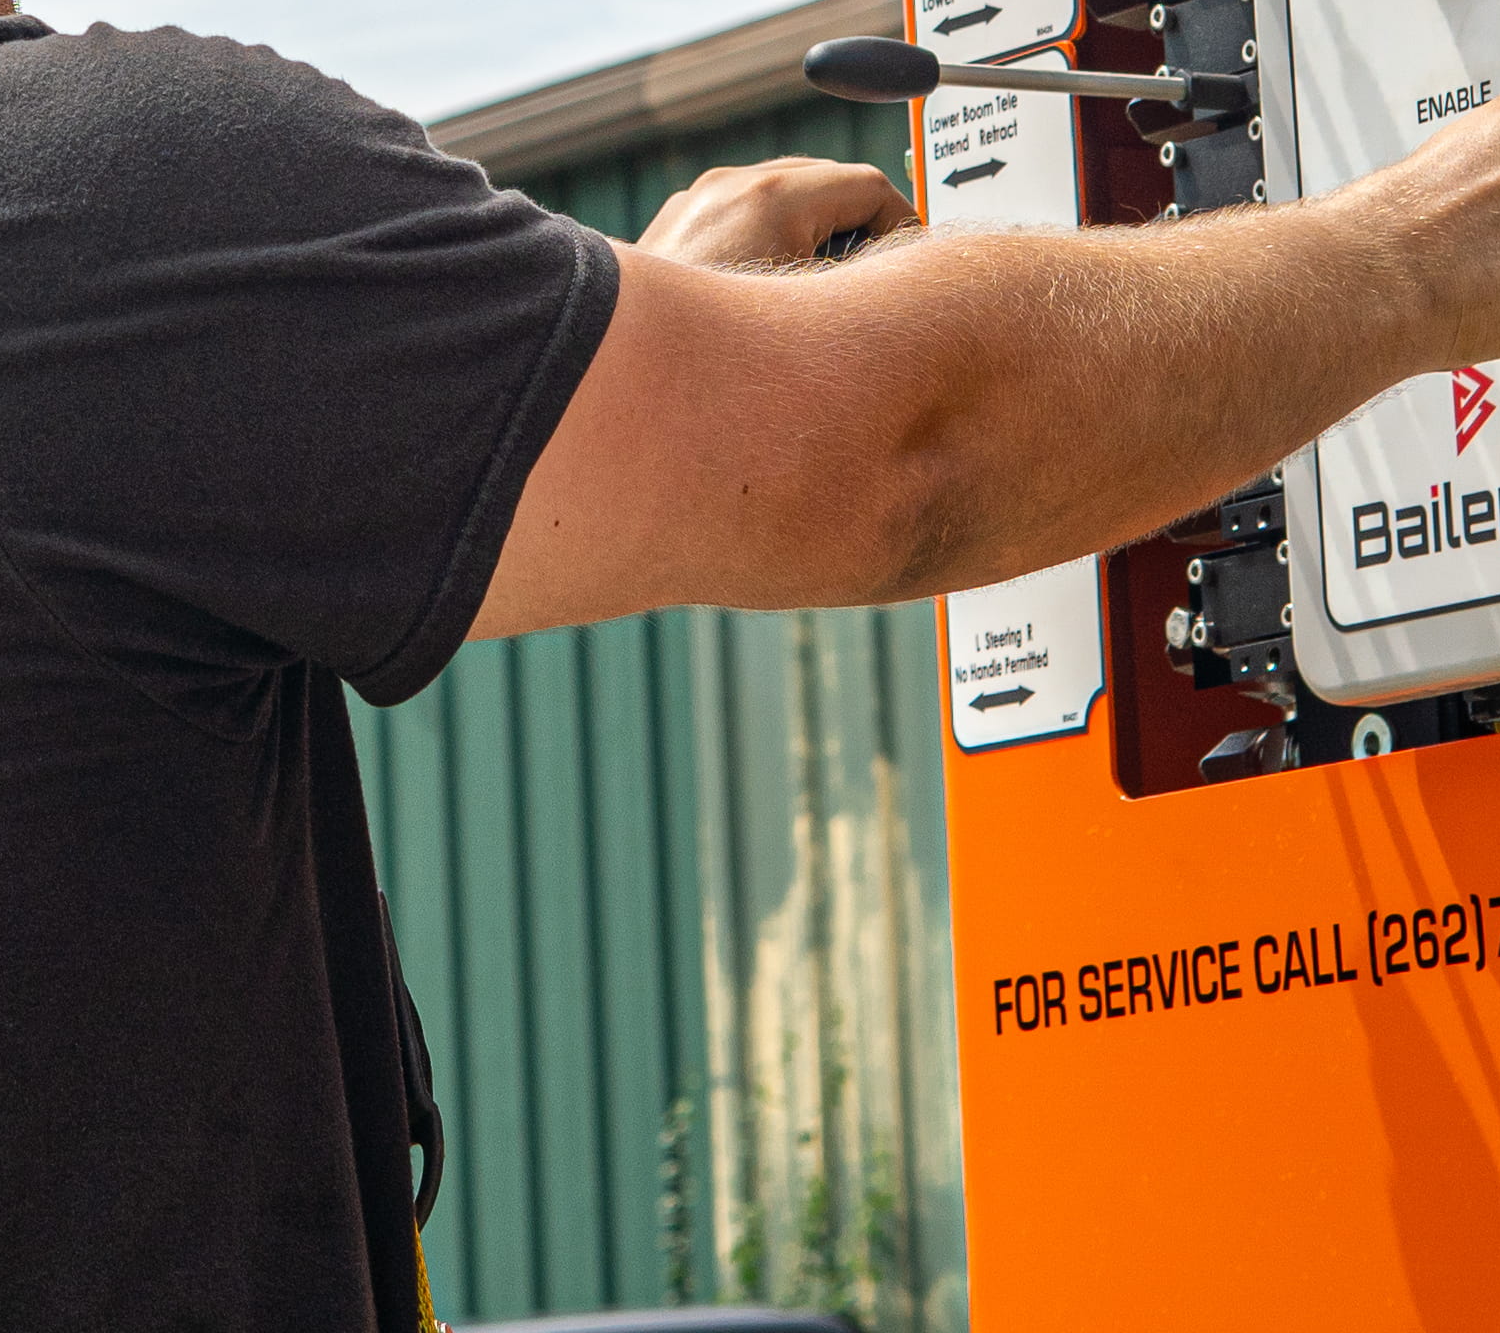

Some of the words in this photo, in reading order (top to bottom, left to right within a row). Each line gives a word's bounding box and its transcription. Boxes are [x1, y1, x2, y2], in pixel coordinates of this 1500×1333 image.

[929, 107, 960, 135] Lower
[962, 99, 994, 125] Boom
[996, 92, 1018, 115] Tele
[1416, 80, 1492, 125] ENABLE
[934, 133, 970, 161] Extend
[979, 118, 1019, 145] Retract
[985, 625, 1023, 649] Steering
[1026, 623, 1033, 641] R
[955, 664, 969, 684] No
[970, 656, 1003, 682] Handle
[1005, 648, 1049, 674] Permitted
[993, 970, 1068, 1036] FOR
[1078, 939, 1243, 1024] SERVICE
[1254, 922, 1358, 996] CALL
